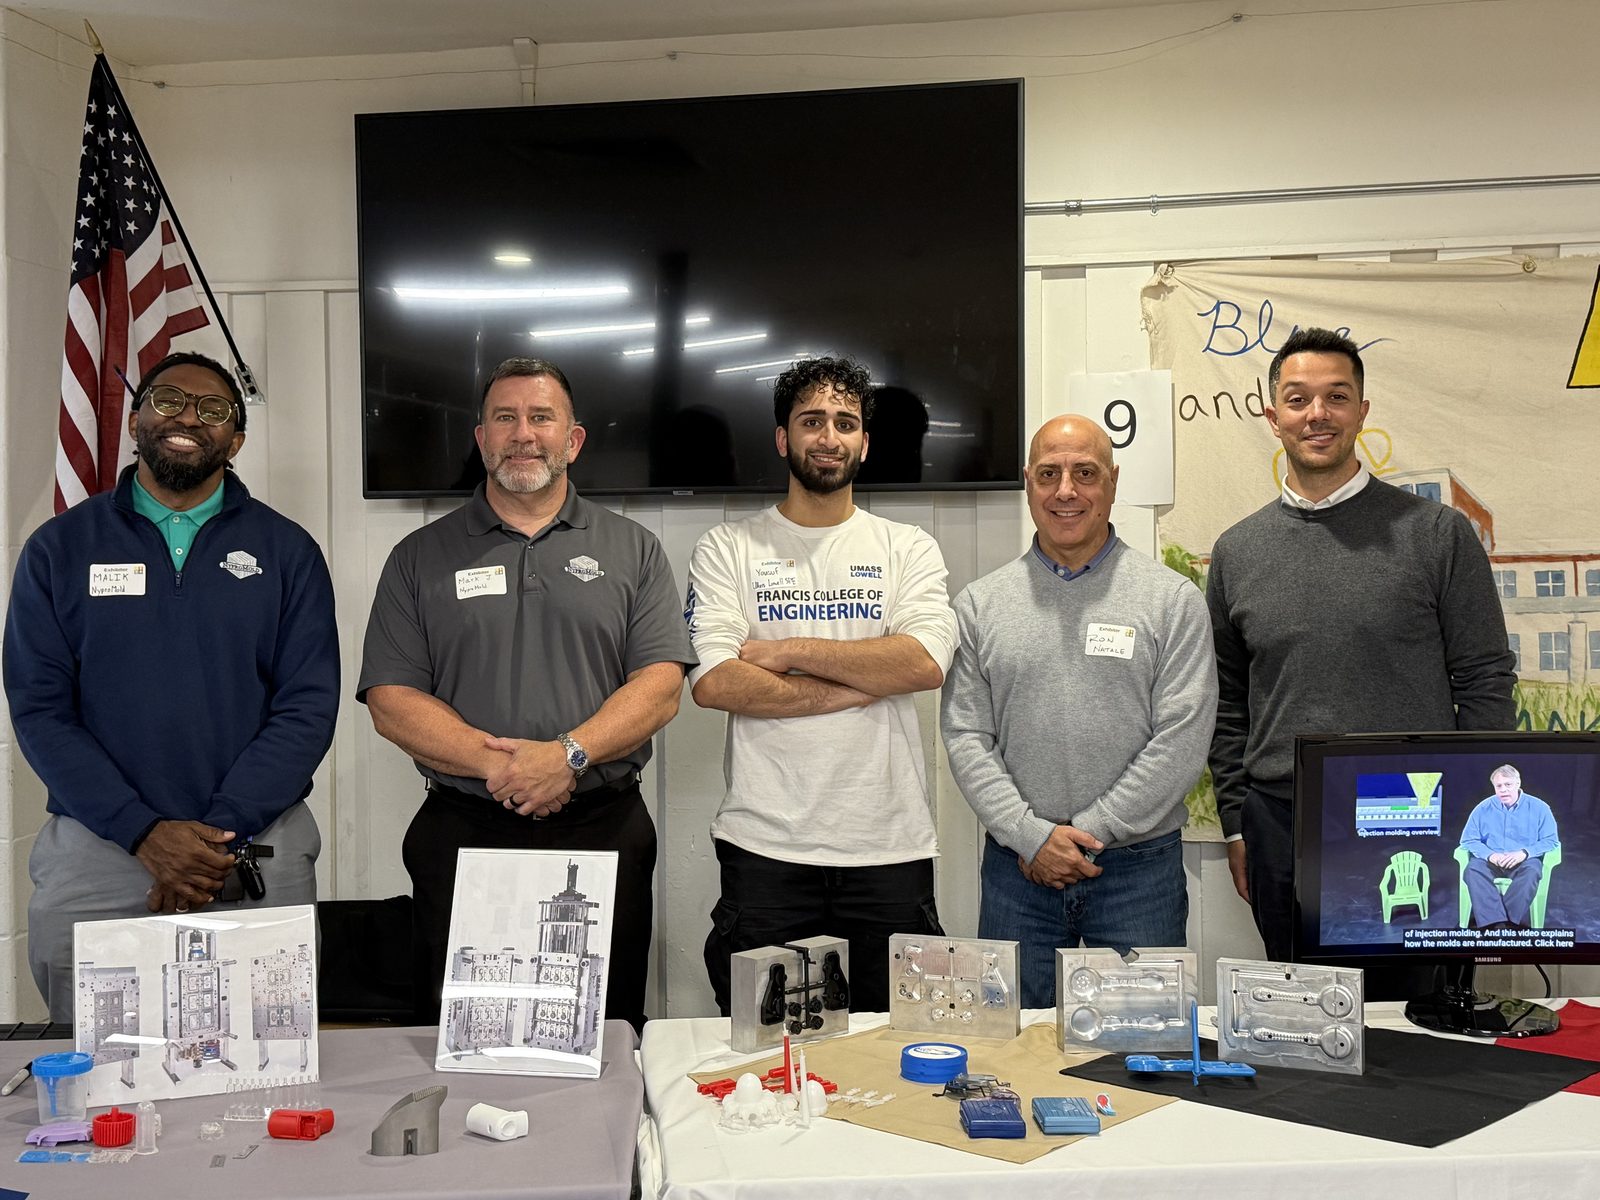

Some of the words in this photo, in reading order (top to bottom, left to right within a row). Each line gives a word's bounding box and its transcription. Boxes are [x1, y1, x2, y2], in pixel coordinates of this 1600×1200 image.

[1179, 376, 1265, 421] and
[1104, 399, 1137, 449] 9
[850, 565, 882, 573] UMASS
[93, 573, 129, 582] MALIK
[756, 589, 811, 602] FRANCIS
[813, 589, 864, 602] COLLEGE
[867, 589, 883, 601] OF
[758, 602, 882, 622] ENGINEERING
[1087, 634, 1114, 643] RON
[1385, 829, 1410, 837] molding
[1404, 929, 1414, 938] of
[1414, 929, 1448, 939] injection
[1449, 929, 1482, 939] molding.
[1484, 928, 1500, 937] And
[1501, 928, 1517, 937] this
[1518, 928, 1540, 937] video
[1541, 928, 1574, 939] explains
[1404, 939, 1421, 948] how
[1422, 939, 1436, 948] the
[1436, 939, 1461, 948] molds
[1476, 938, 1533, 947] manufactured.
[1534, 938, 1555, 948] Click
[1555, 939, 1574, 948] here
